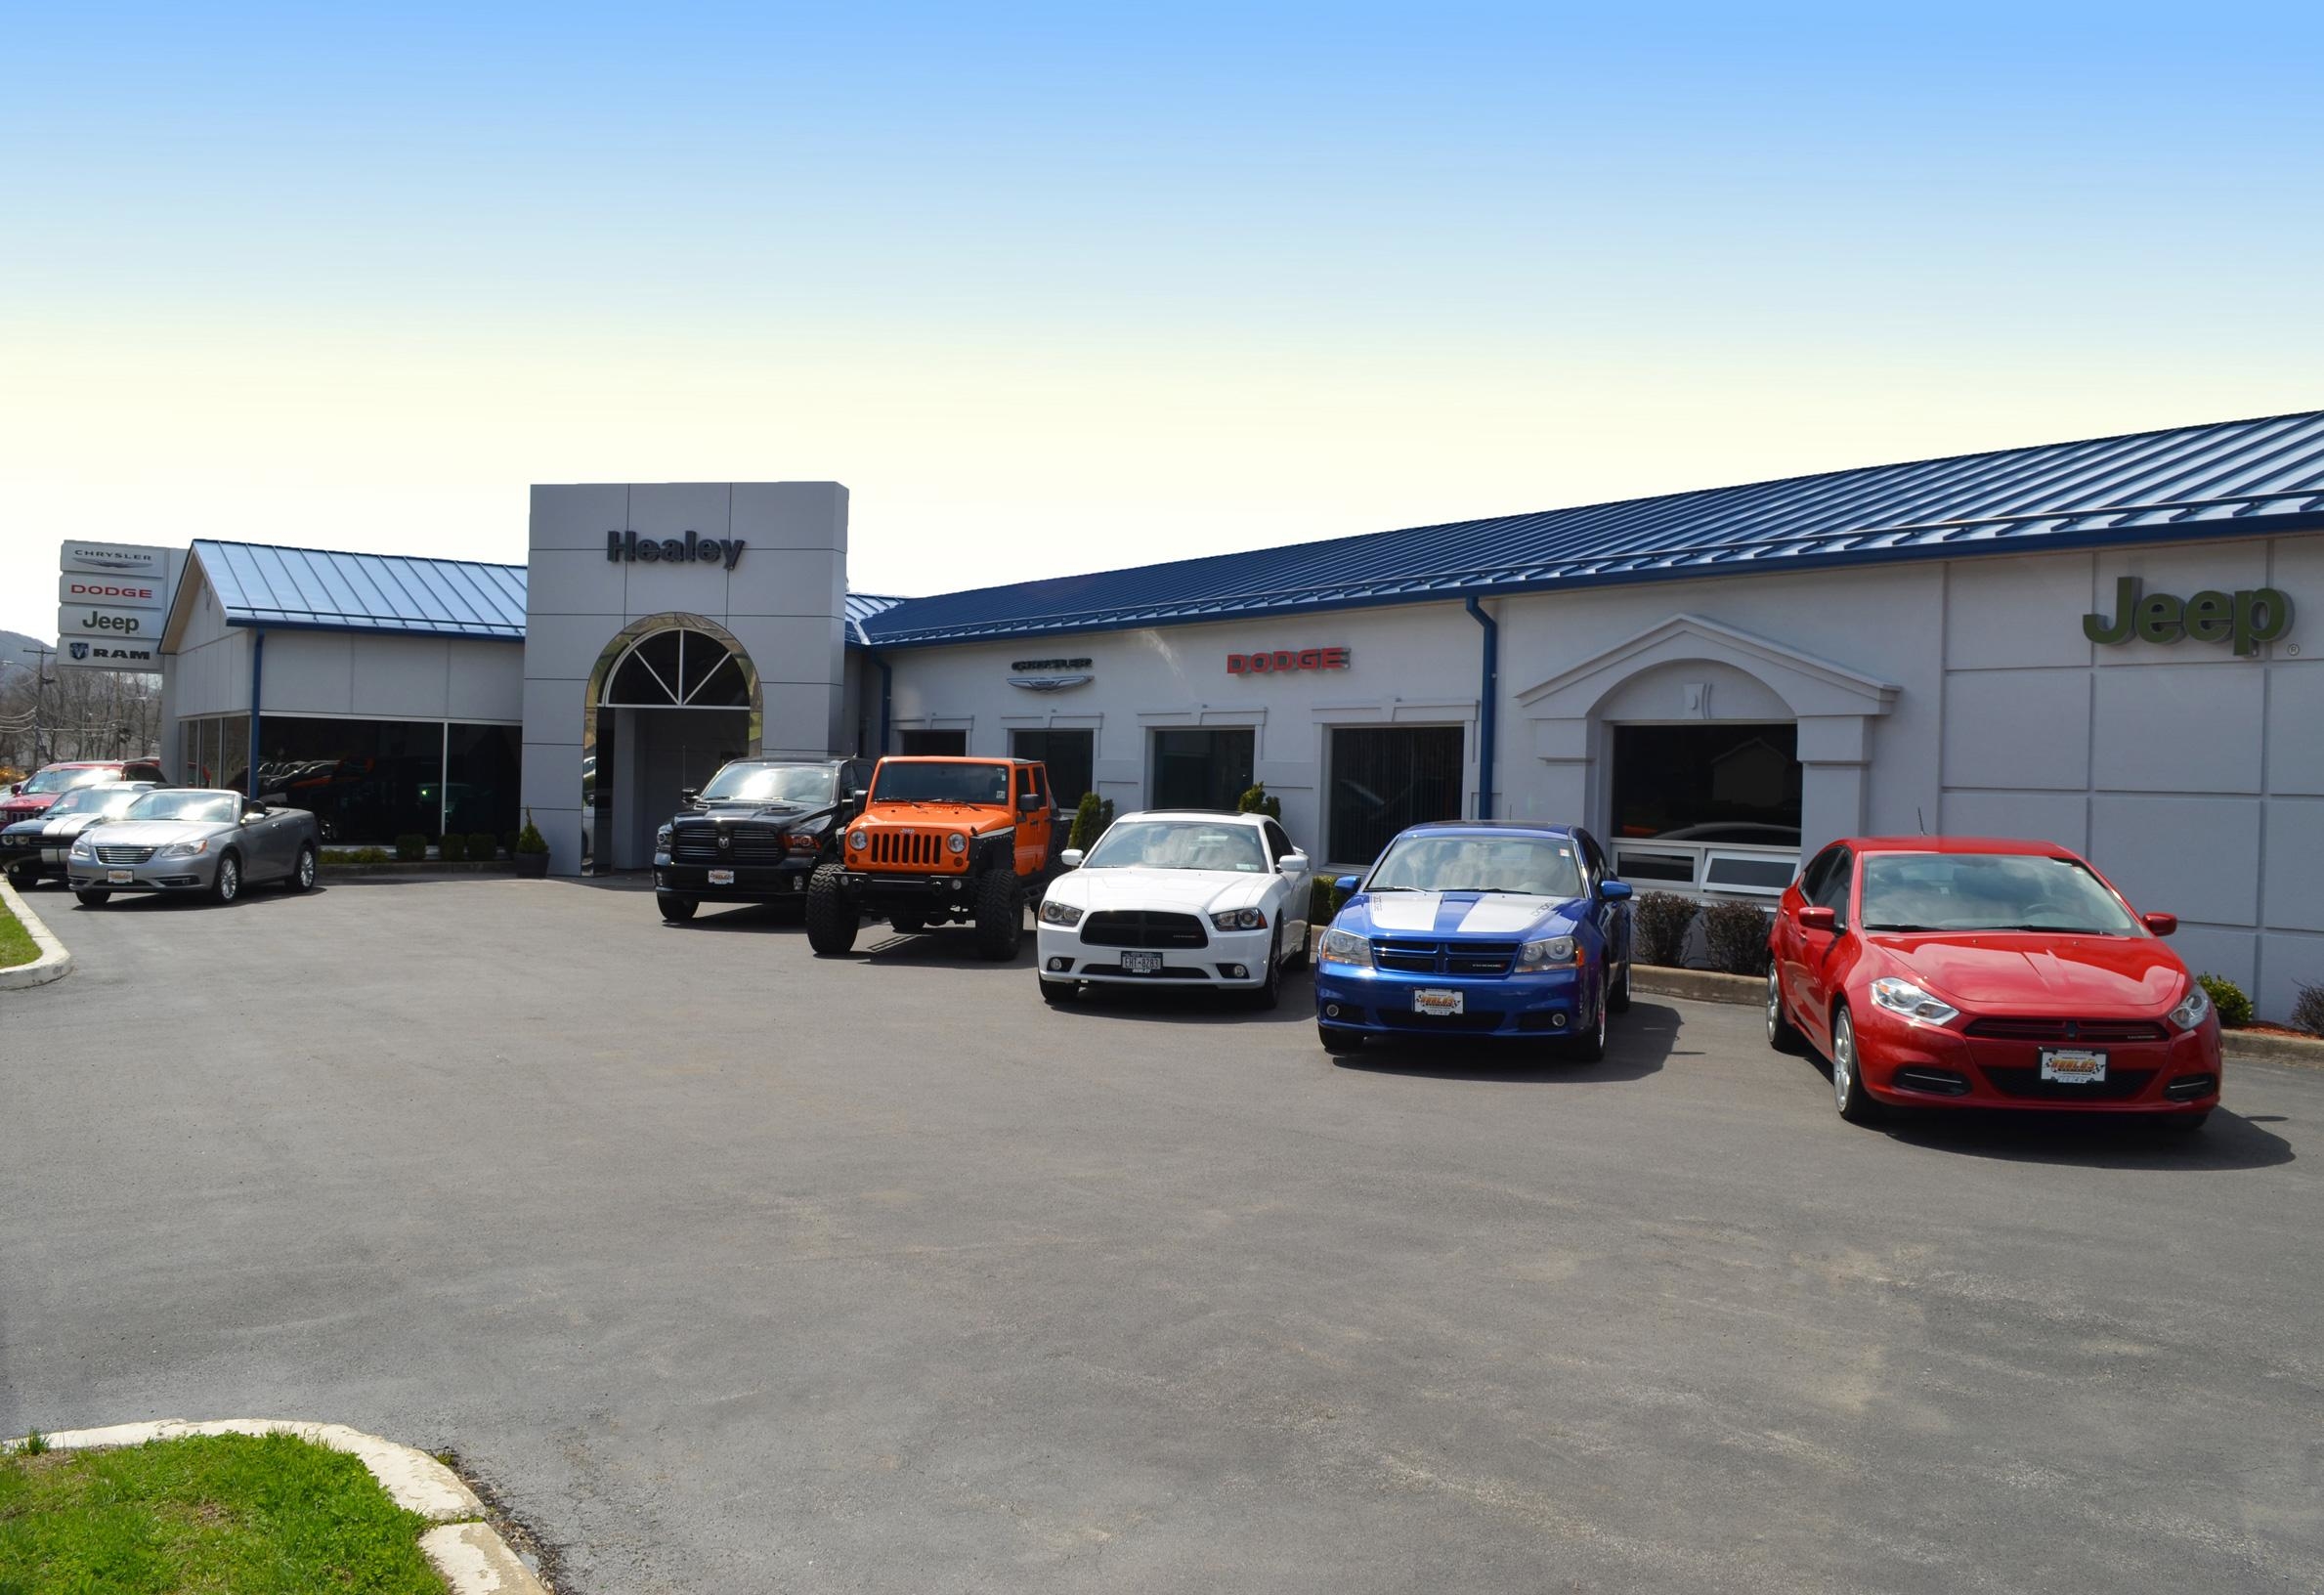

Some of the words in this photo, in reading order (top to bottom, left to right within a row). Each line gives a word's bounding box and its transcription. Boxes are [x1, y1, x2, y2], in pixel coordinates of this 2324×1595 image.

[74, 549, 151, 560] CHRYSLER
[607, 530, 746, 570] Healey
[71, 584, 152, 598] DODGE
[82, 611, 140, 634] Jeep
[2083, 576, 2296, 658] Jeep
[93, 648, 151, 660] RAM
[1227, 647, 1352, 675] DODGE
